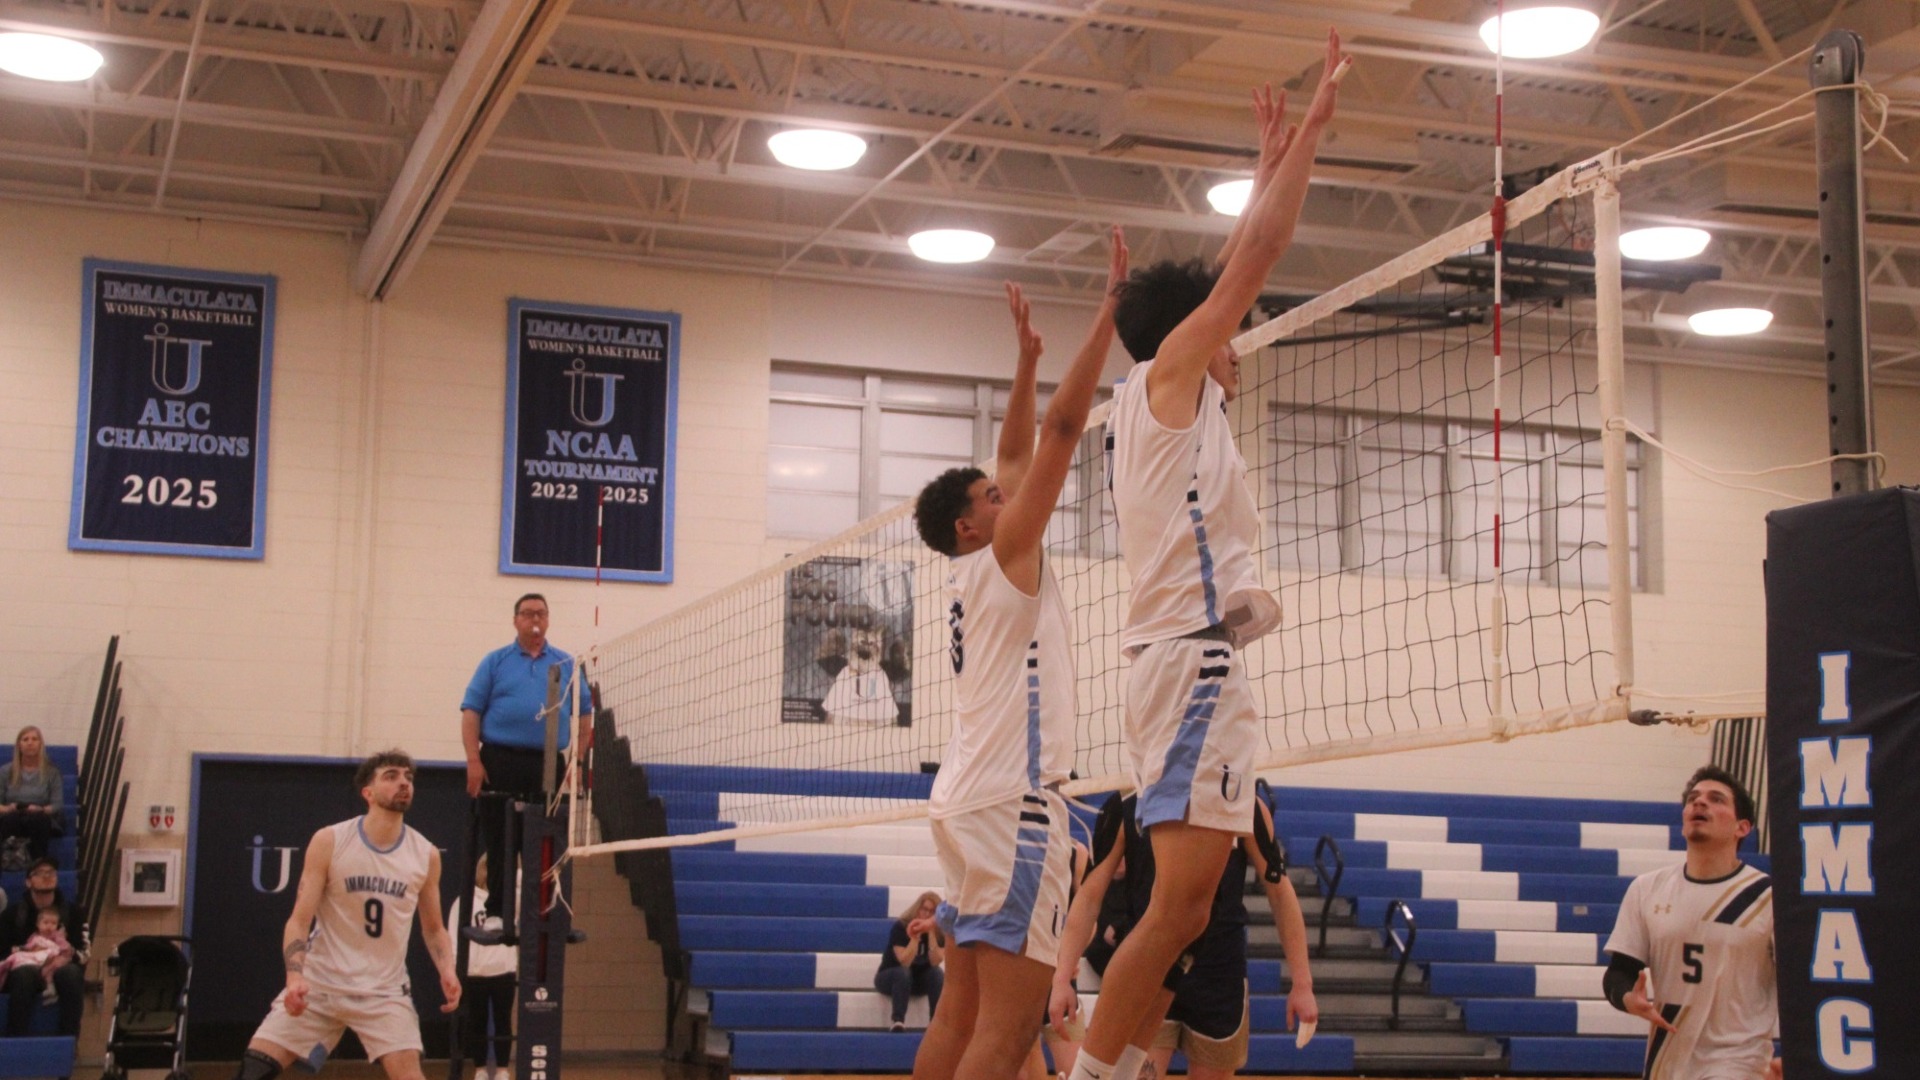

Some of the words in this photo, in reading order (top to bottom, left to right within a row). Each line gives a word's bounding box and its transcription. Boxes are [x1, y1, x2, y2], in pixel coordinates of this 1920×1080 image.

[102, 280, 257, 312] IMMACULATA
[104, 301, 168, 319] WOMEN'S
[171, 307, 254, 326] BASKETBALL
[526, 318, 664, 348] IMMACULATA
[528, 339, 585, 355] WOMEN'S
[587, 344, 662, 361] BASKETBALL
[137, 398, 211, 430] AEC
[96, 426, 250, 457] CHAMPIONS
[545, 430, 638, 462] NCAA
[524, 459, 658, 485] TOURNAMENT
[121, 474, 218, 509] 2025
[531, 482, 578, 500] 2022
[602, 485, 649, 504] 2025
[1799, 650, 1876, 1074] IMMAC
[364, 897, 383, 938] 9
[1682, 942, 1704, 984] 5
